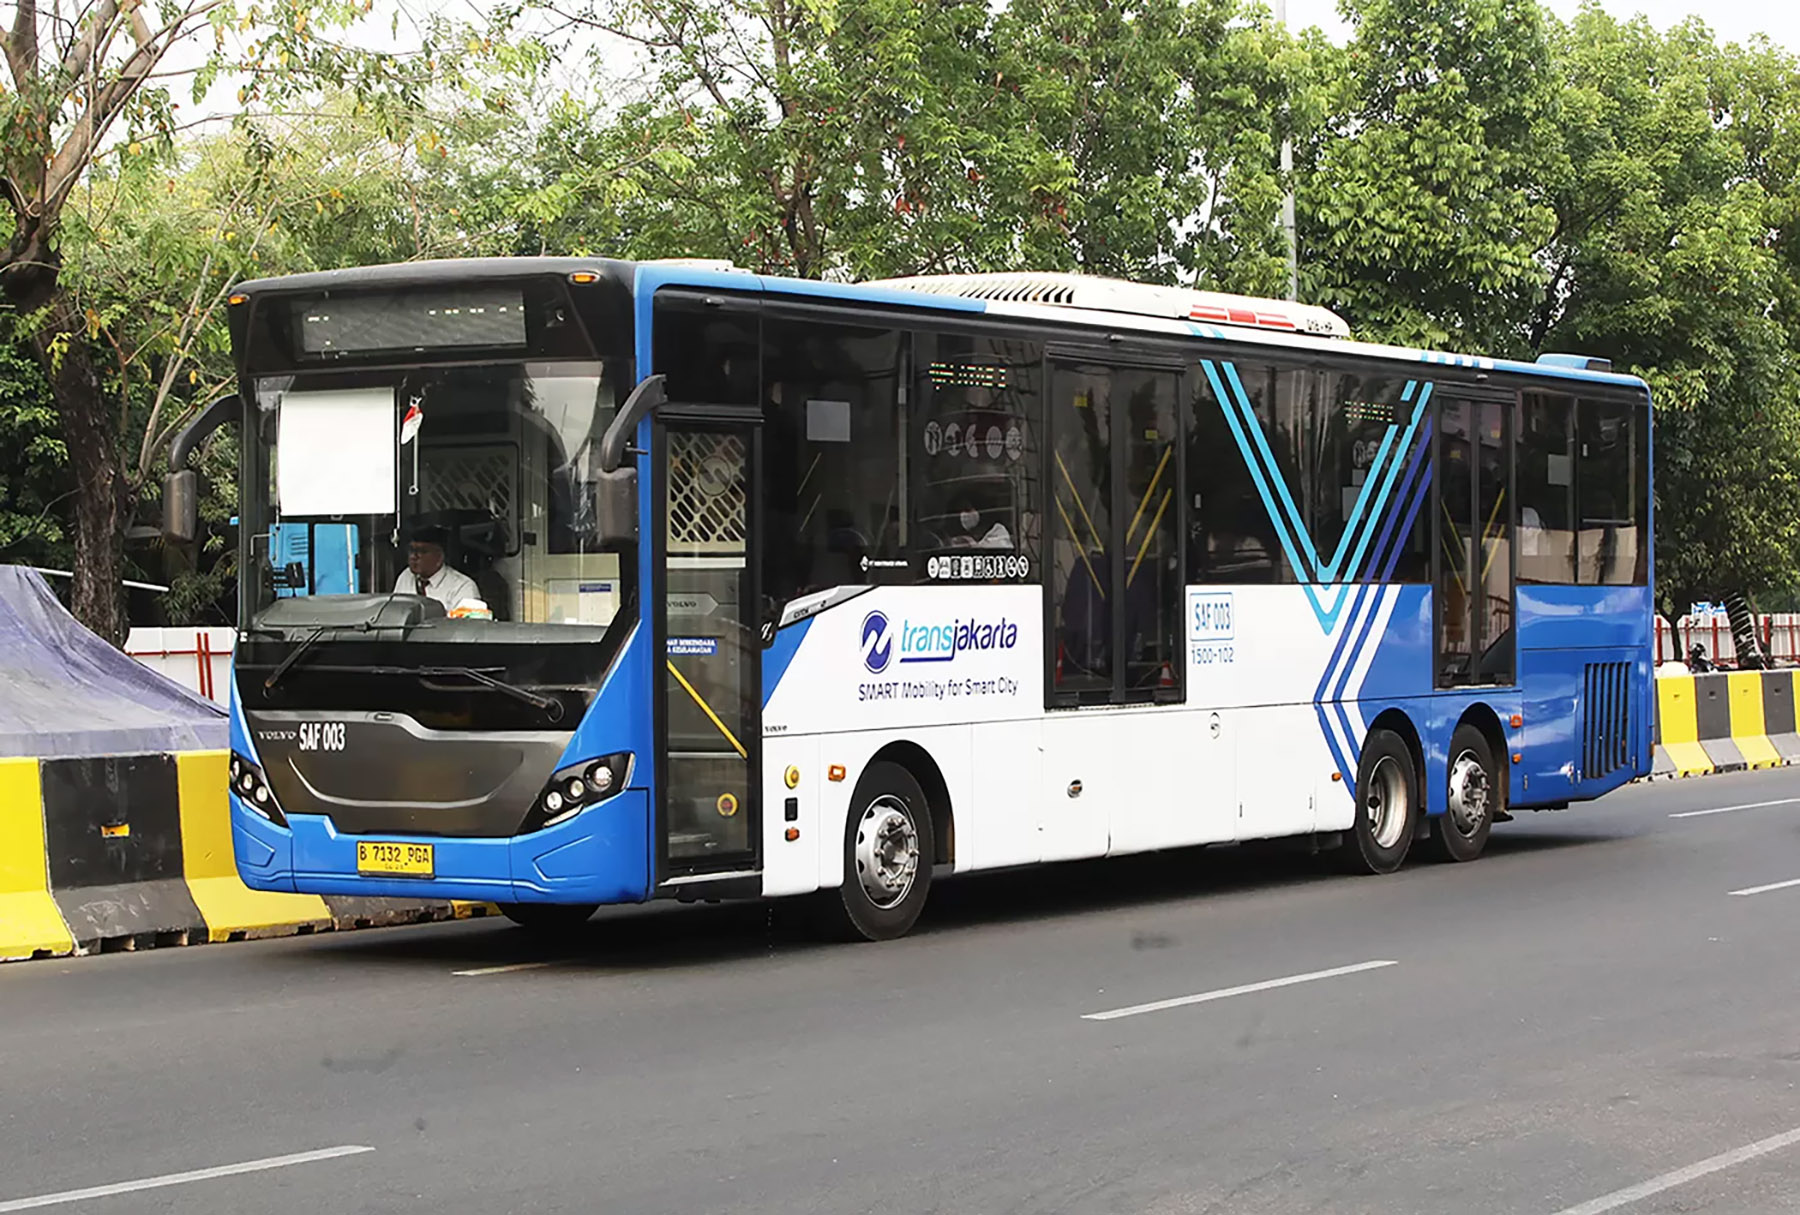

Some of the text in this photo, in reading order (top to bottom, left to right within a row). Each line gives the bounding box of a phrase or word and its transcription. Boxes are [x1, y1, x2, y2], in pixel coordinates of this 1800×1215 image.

[1195, 602, 1231, 631] SAF 003
[899, 617, 1018, 663] transjakarta
[1191, 647, 1234, 664] 1500-102
[858, 676, 1019, 701] SMART Mobility for Smart City
[258, 730, 297, 740] VOLVO
[299, 722, 346, 751] SAF 003
[359, 845, 430, 864] B 7132 PGA
